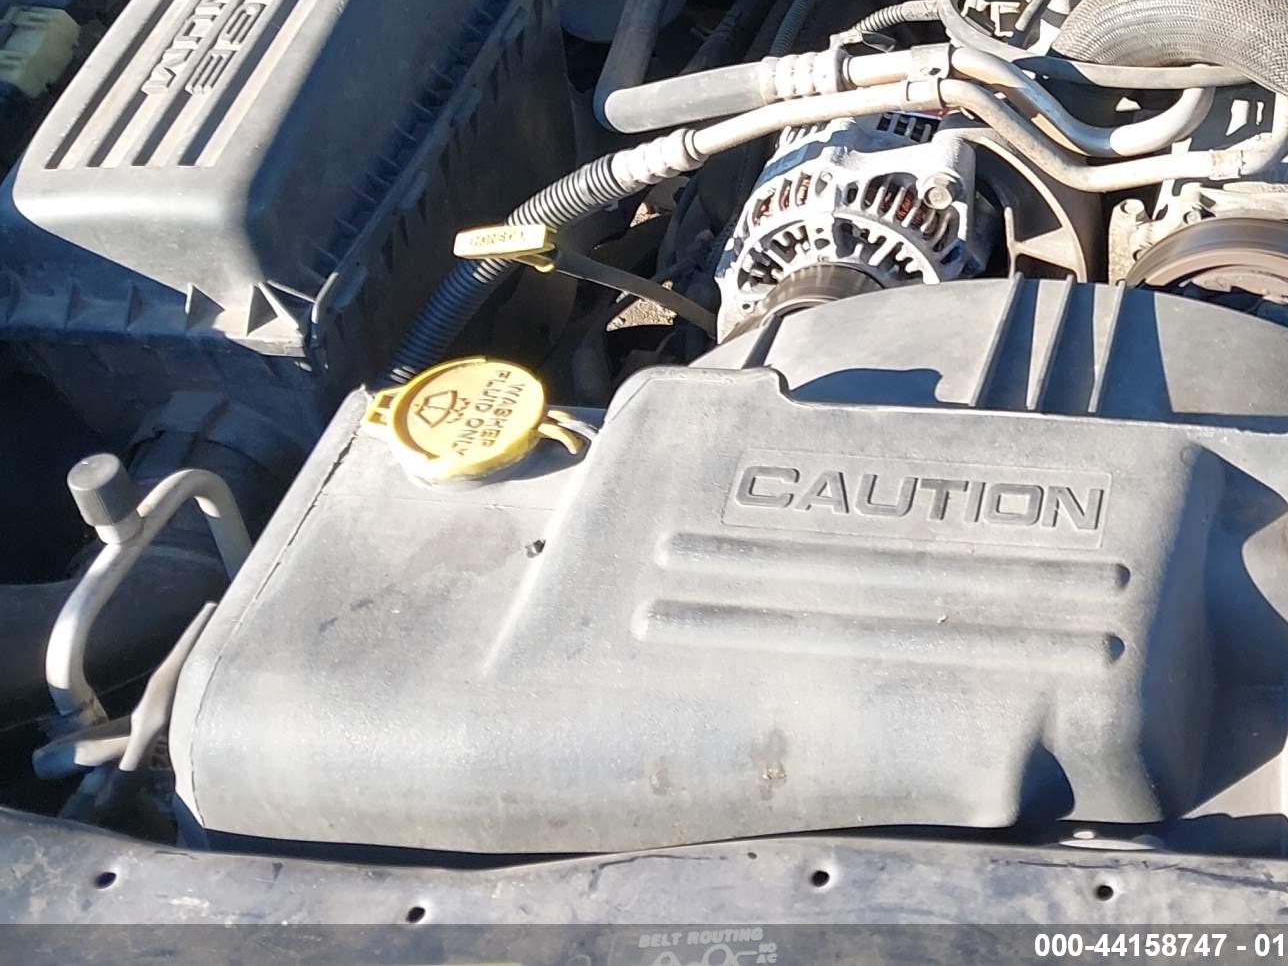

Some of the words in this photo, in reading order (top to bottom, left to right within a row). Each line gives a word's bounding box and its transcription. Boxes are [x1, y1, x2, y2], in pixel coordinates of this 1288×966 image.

[480, 383, 526, 447] WASHER
[451, 418, 485, 456] ONLY
[735, 465, 1104, 531] CAUTION
[638, 934, 682, 948] BELT
[686, 927, 764, 945] ROUTING
[758, 942, 777, 953] NO
